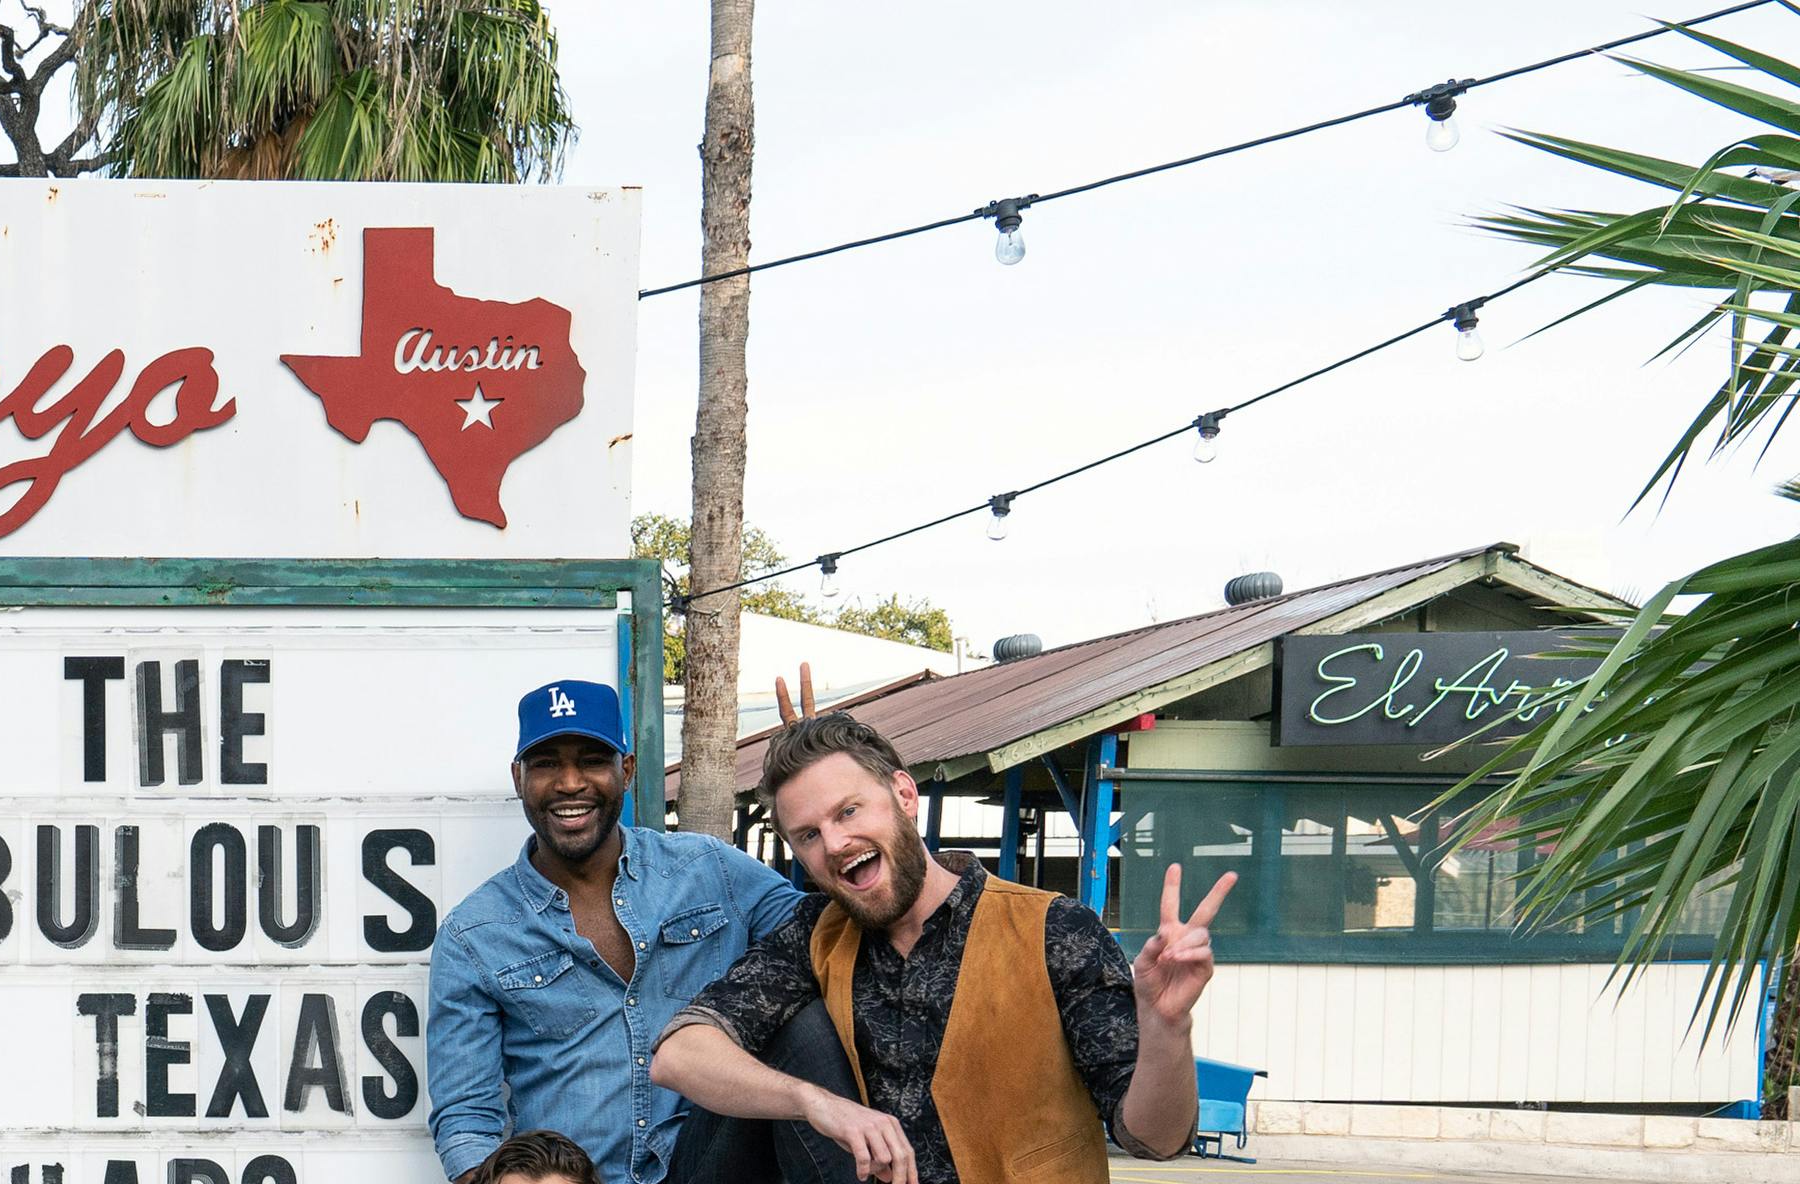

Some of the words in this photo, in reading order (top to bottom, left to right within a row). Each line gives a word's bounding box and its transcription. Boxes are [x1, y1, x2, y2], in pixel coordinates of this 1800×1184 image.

[394, 327, 543, 374] Austin
[64, 656, 271, 787] THE
[548, 686, 576, 718] LA
[1311, 643, 1424, 725] El
[76, 990, 419, 1120] TEXAS
